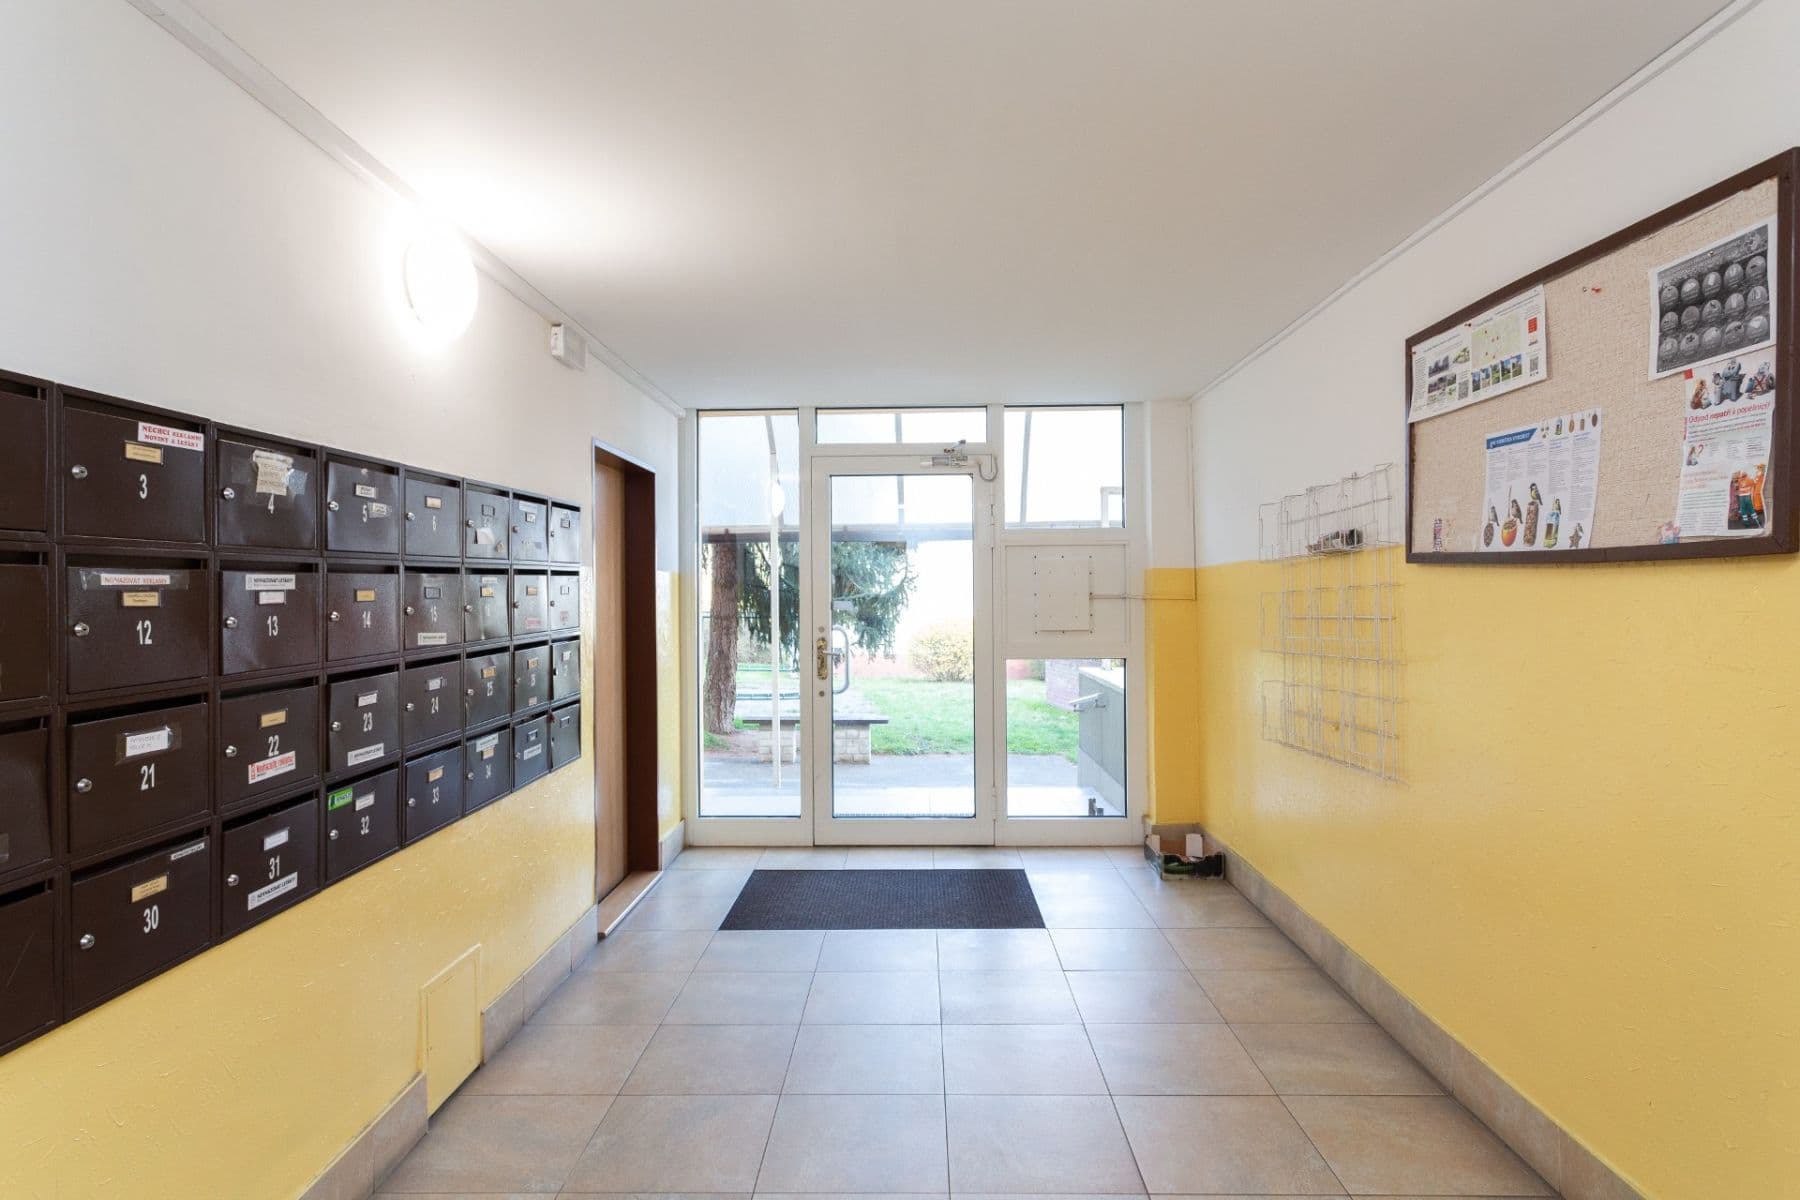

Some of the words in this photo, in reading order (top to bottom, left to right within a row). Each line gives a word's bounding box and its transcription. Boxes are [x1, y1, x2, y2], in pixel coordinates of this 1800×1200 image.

[139, 474, 148, 499] 3
[267, 493, 275, 514] 4
[362, 504, 368, 523] 5
[267, 615, 279, 637] 13
[362, 610, 371, 628] 14
[136, 620, 152, 645] 12
[431, 696, 439, 714] 24
[362, 711, 374, 732] 23
[268, 734, 280, 757] 22
[140, 763, 155, 791] 21
[360, 815, 371, 836] 32
[268, 855, 280, 880] 31
[143, 904, 159, 934] 30
